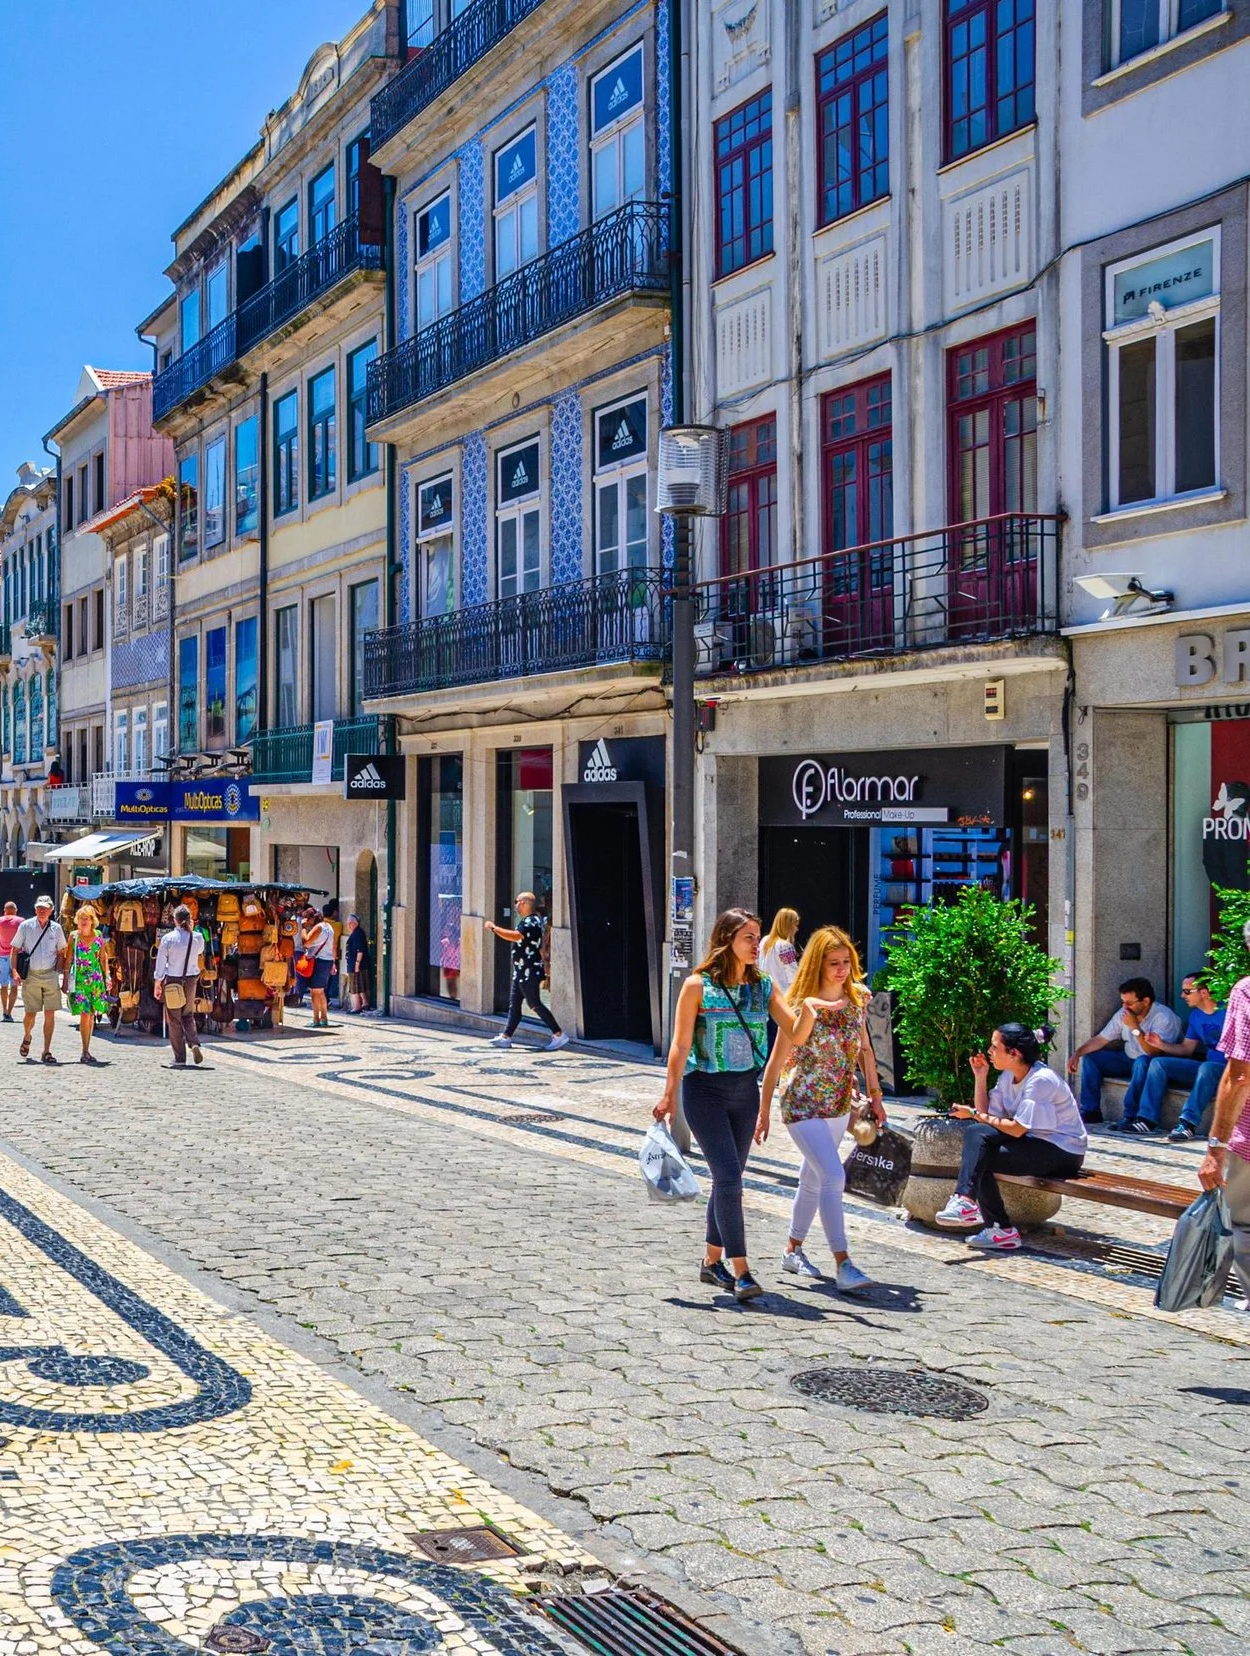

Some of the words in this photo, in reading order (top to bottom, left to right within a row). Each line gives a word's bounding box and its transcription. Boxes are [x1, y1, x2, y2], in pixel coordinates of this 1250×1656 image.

[607, 90, 629, 112] adidas
[1139, 268, 1203, 297] FIRENZE
[611, 435, 634, 450] adidas
[511, 474, 529, 489] adidas
[584, 766, 618, 783] adidas
[1076, 743, 1090, 801] 349
[350, 779, 387, 789] adidas
[827, 767, 919, 802] flormar
[120, 804, 169, 814] MultiOpticas
[183, 791, 223, 813] MultiOpticas
[843, 809, 882, 820] Professional
[882, 809, 916, 820] Make-Up
[1202, 817, 1250, 840] PRO
[872, 873, 882, 916] PERFUME
